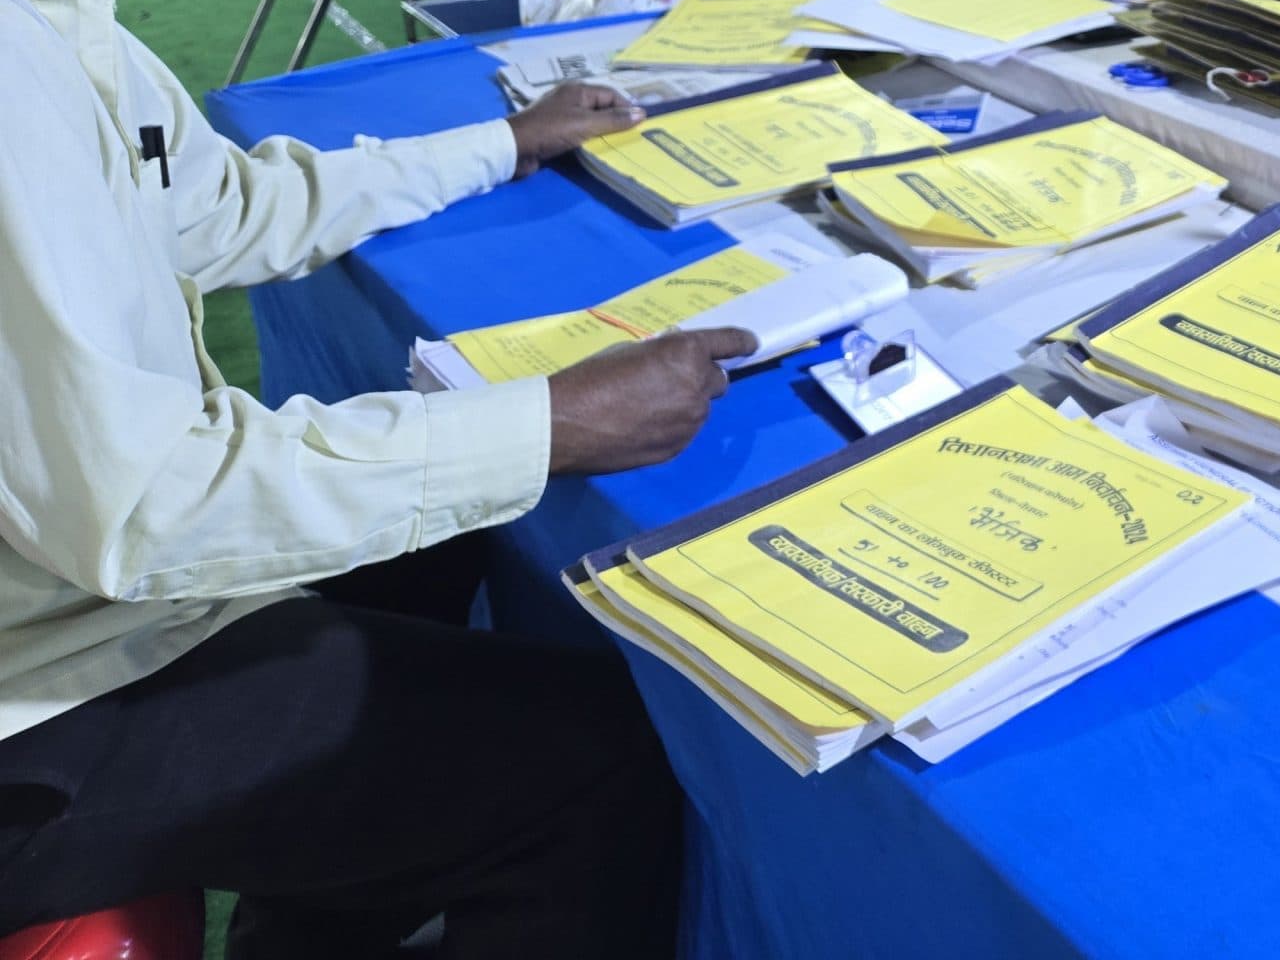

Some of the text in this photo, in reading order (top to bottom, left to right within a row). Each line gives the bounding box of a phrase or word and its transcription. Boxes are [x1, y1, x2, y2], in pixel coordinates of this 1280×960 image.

[937, 436, 1051, 471] विधानसभा
[1045, 458, 1089, 480] आम
[897, 520, 920, 534] का
[917, 571, 950, 591] 100
[896, 610, 944, 640] वाहन
